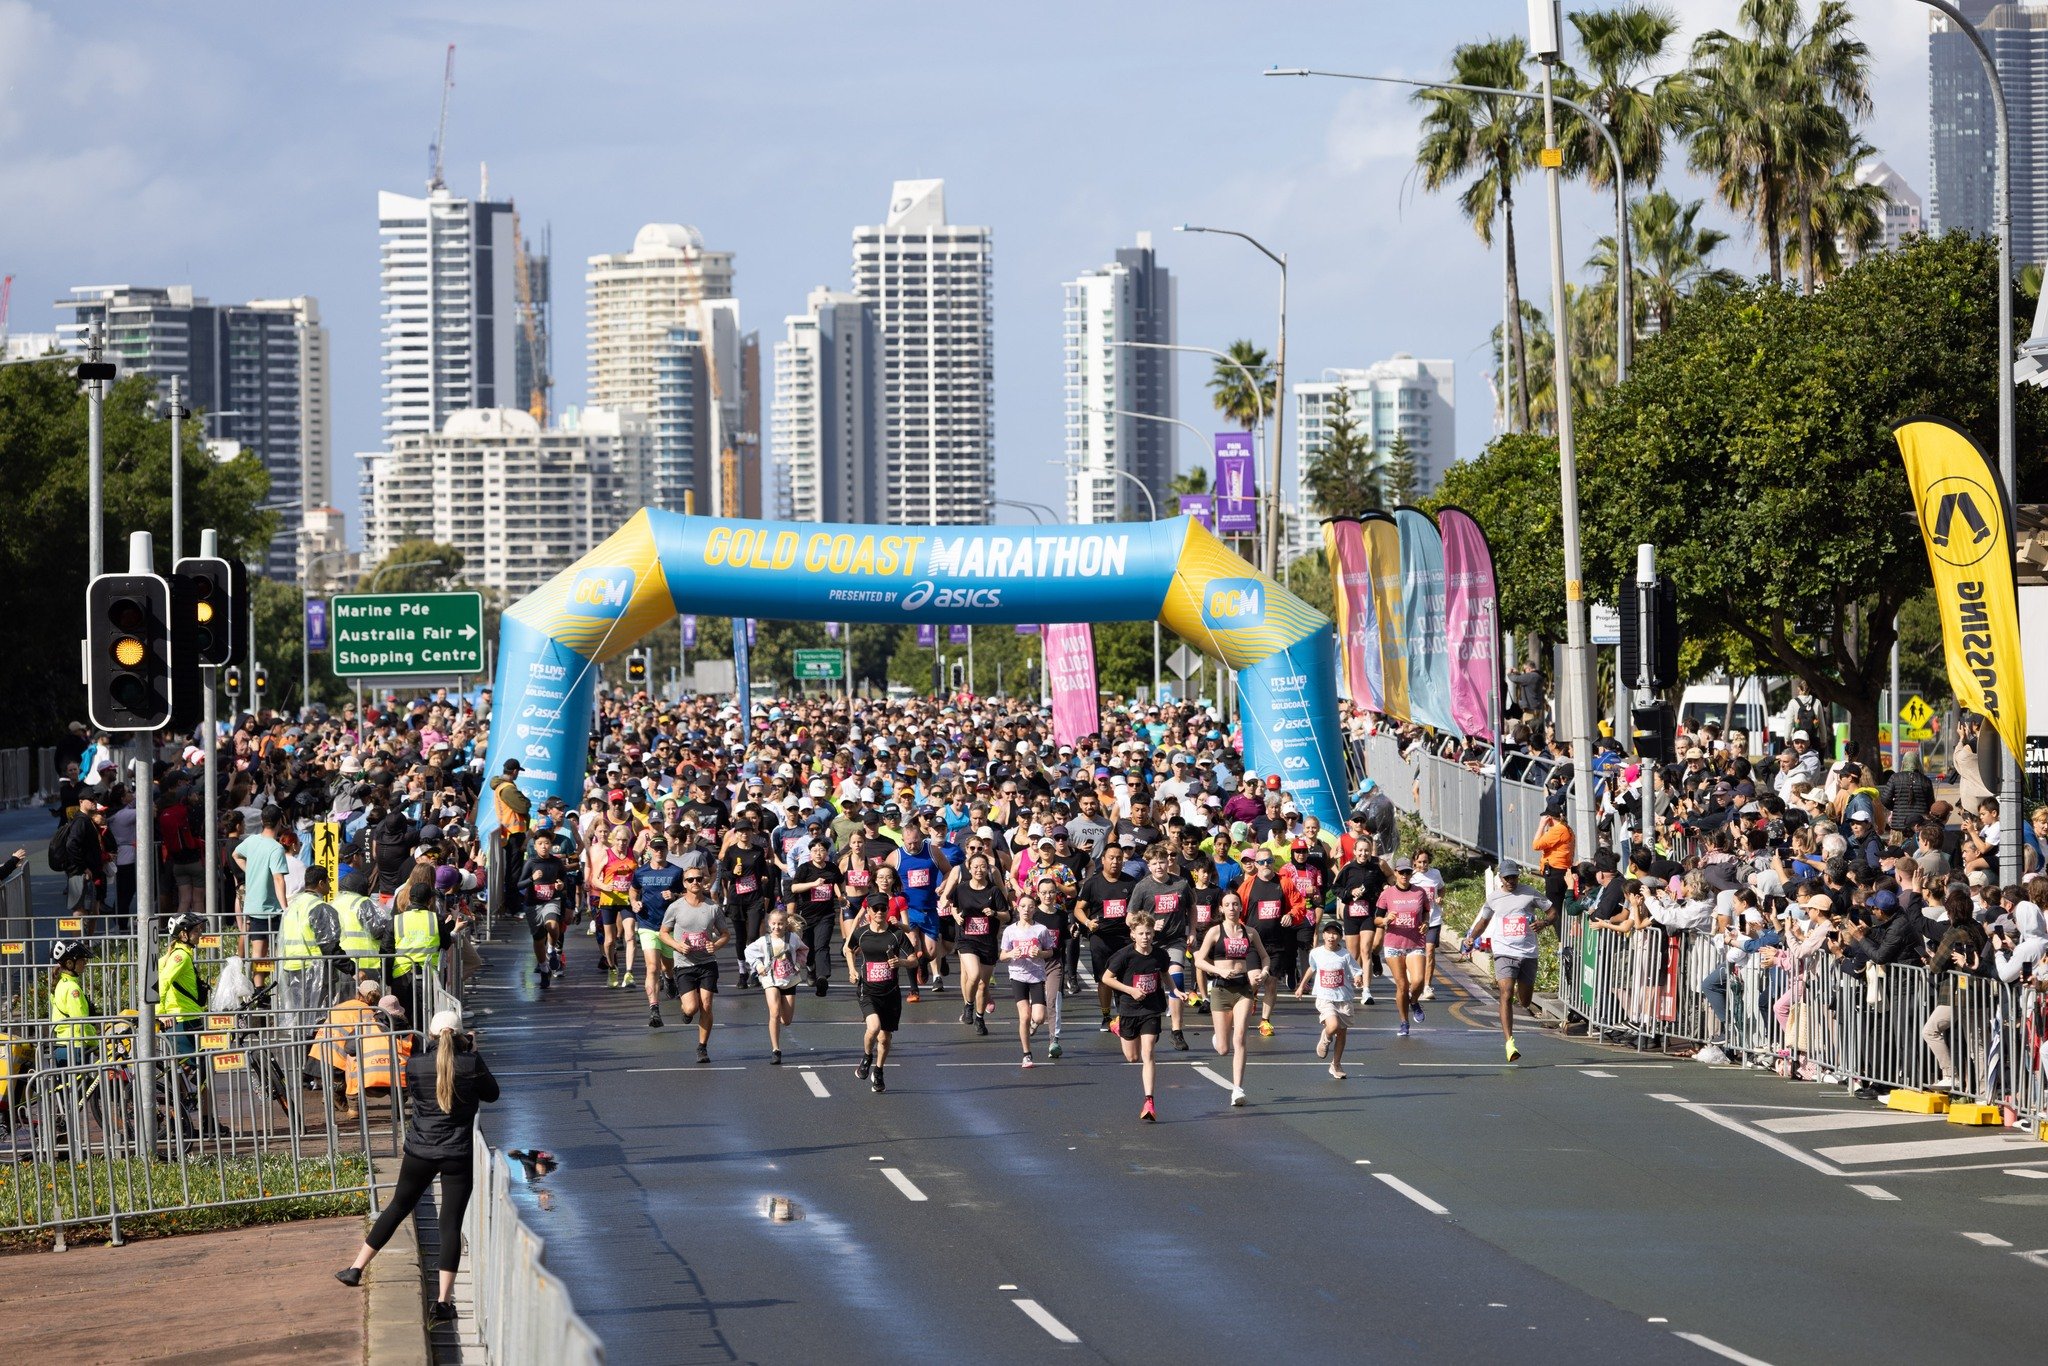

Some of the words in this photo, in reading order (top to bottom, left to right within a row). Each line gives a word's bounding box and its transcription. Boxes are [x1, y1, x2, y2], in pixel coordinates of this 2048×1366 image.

[703, 527, 800, 571] GOLD
[804, 532, 926, 577] COAST
[927, 535, 1129, 578] MARATHON
[574, 577, 628, 607] GCM
[829, 589, 883, 602] PRESENTED
[885, 592, 898, 602] BY
[1209, 588, 1259, 618] GCM
[338, 604, 392, 617] Marine
[400, 603, 430, 616] Pde
[339, 628, 416, 641] Australia
[423, 626, 453, 640] Fair
[339, 651, 414, 665] Shopping
[421, 649, 477, 662] Centre
[526, 744, 551, 758] GCA
[1284, 756, 1310, 768] GCA
[533, 789, 548, 799] cpl
[1106, 905, 1125, 915] 51158
[1158, 900, 1177, 911] 53191
[1503, 922, 1525, 932] 50249
[1228, 943, 1247, 954] 53149
[211, 1017, 230, 1025] TFH
[204, 1035, 222, 1043] TFH
[217, 1055, 239, 1065] TFH
